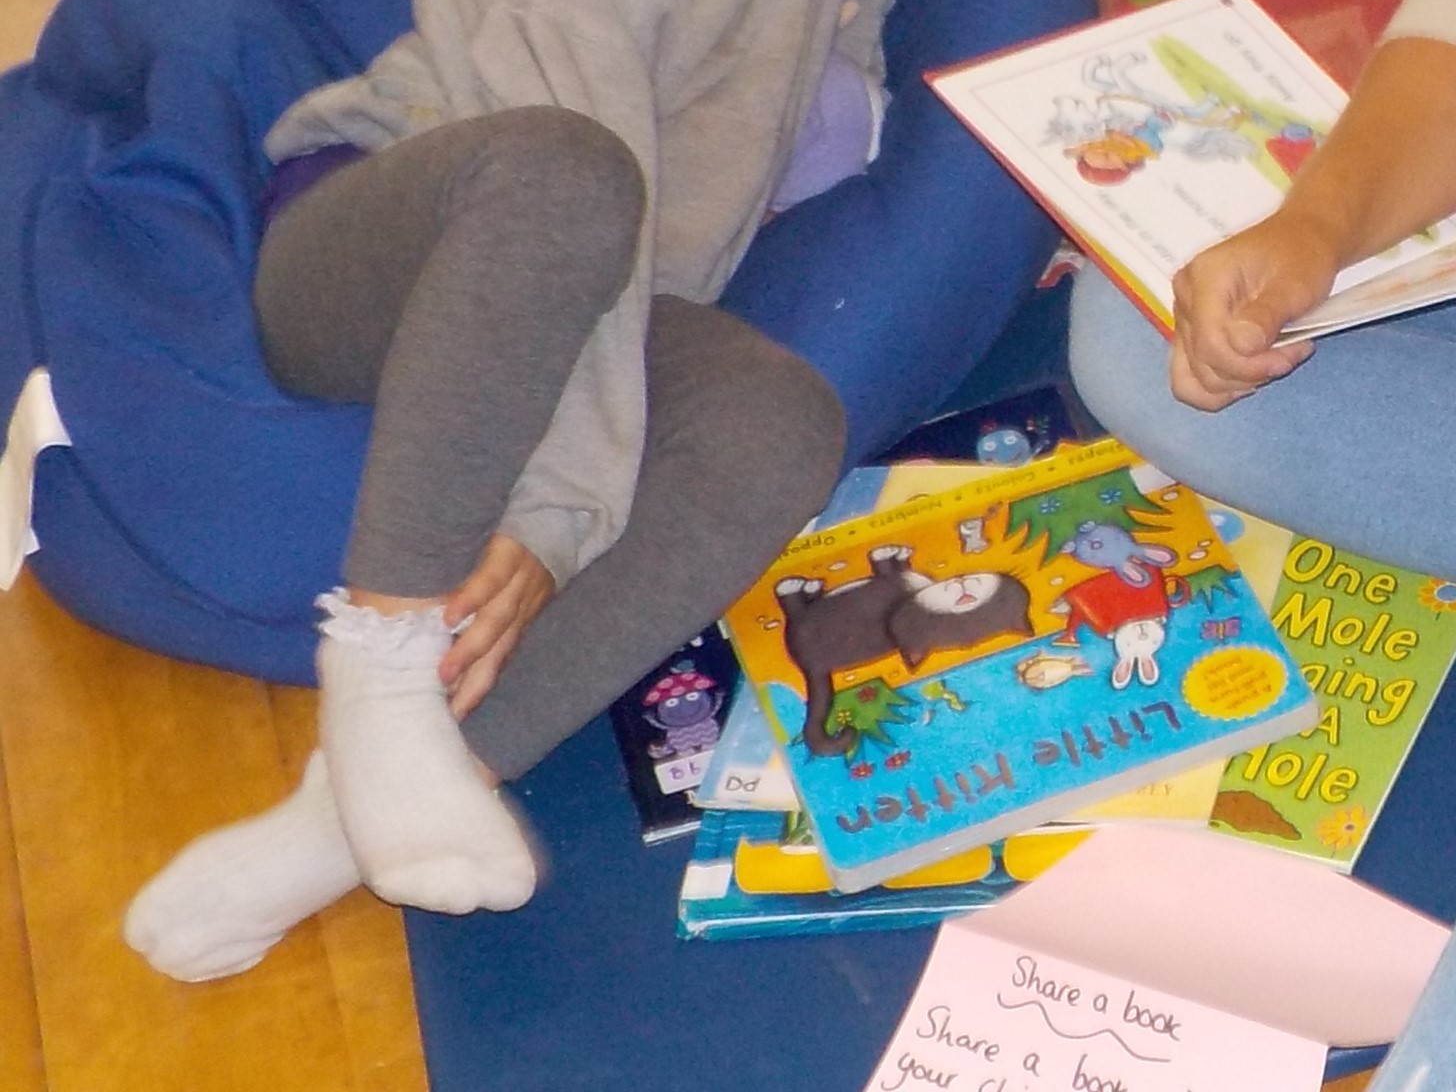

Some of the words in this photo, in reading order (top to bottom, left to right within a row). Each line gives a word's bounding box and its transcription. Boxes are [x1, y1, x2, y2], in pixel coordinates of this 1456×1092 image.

[869, 500, 943, 529] Numbers
[975, 471, 1036, 495] Colours
[1283, 538, 1398, 604] One
[1271, 592, 1419, 661] Mole
[1033, 700, 1183, 768] Little
[725, 776, 761, 793] Dd
[835, 751, 1016, 834] Kitten
[1012, 955, 1081, 1006] Share
[1093, 994, 1109, 1014] a
[1123, 990, 1182, 1042] book
[880, 1052, 959, 1092] your
[915, 1005, 1001, 1063] Share
[1023, 1052, 1040, 1077] a
